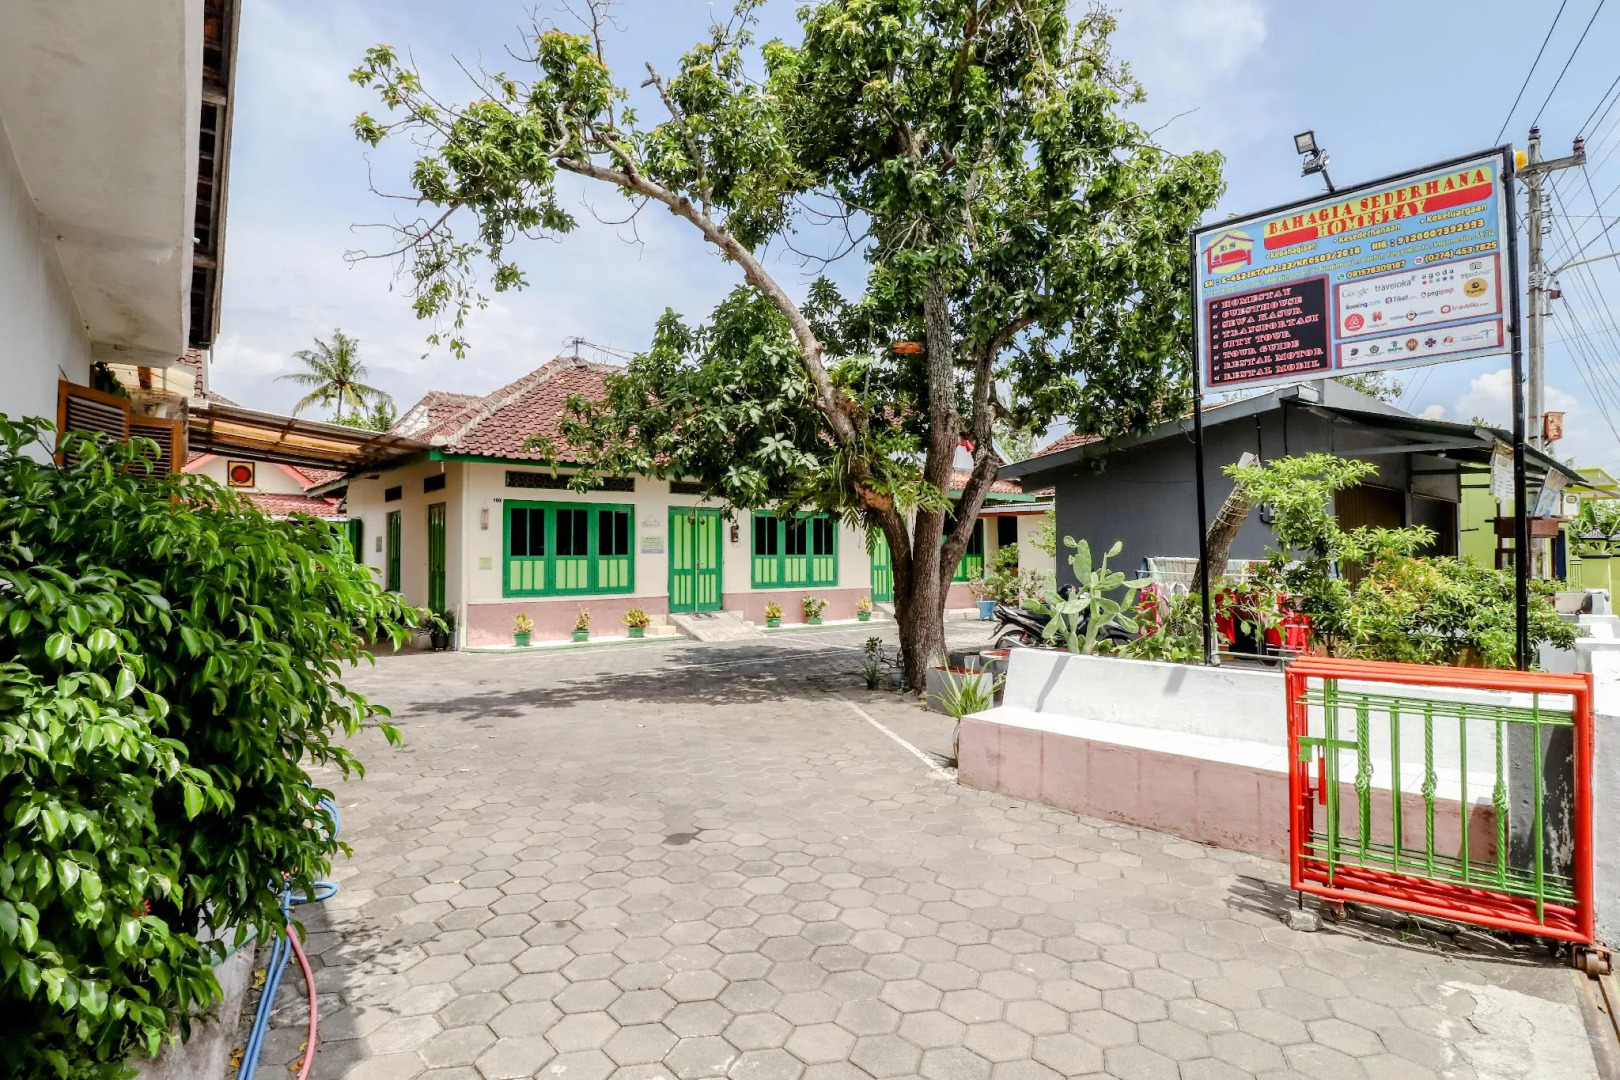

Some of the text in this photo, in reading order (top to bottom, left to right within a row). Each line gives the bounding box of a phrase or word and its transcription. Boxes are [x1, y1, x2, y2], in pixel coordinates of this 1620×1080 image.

[1268, 169, 1486, 235] BAHAGIA SEDERHANA
[1317, 199, 1427, 238] HOMESTAY
[1425, 204, 1487, 223] Kekeluargaan
[1338, 224, 1401, 243] Kesederhanaan
[1270, 243, 1317, 259] Kebahagiaan
[1424, 240, 1498, 264] (0274) 453 7825
[1341, 287, 1369, 299] Google
[1374, 279, 1412, 293] traveloka
[1222, 288, 1292, 309] HOMESTAY
[1222, 296, 1303, 319] GUESTHOUSE
[1222, 307, 1303, 329] SEWA KASUR
[1222, 314, 1320, 338] TRANSPORTASI
[1222, 330, 1291, 348] CITY TOUR
[1222, 340, 1300, 359] TOUR GUIDE
[1223, 347, 1324, 370] RENTAL MOTOR
[1223, 359, 1320, 380] RENTAL MOBIL
